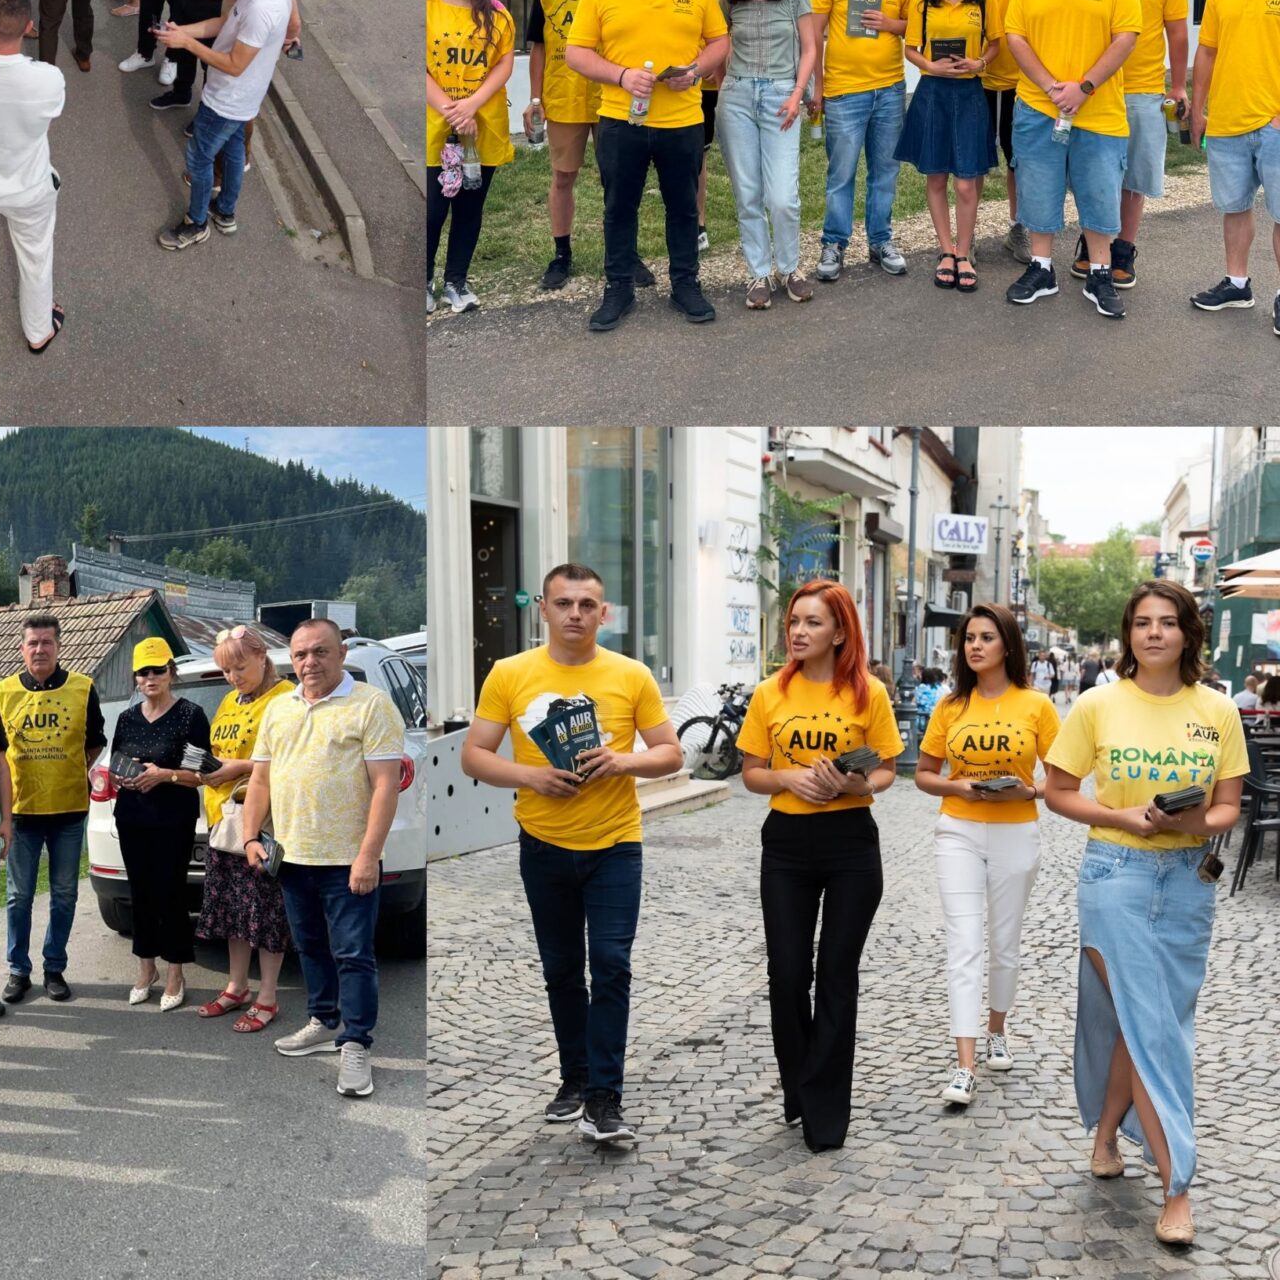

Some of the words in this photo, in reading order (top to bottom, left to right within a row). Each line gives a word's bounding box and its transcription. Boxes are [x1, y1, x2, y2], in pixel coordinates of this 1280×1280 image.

[938, 519, 986, 544] CALY
[22, 713, 59, 729] AUR
[570, 711, 592, 726] AUR
[212, 724, 240, 742] AUR
[571, 726, 578, 735] TE
[578, 723, 593, 733] AUDE
[1192, 728, 1219, 742] AUR
[789, 730, 838, 752] AUR
[962, 735, 1011, 752] AUR
